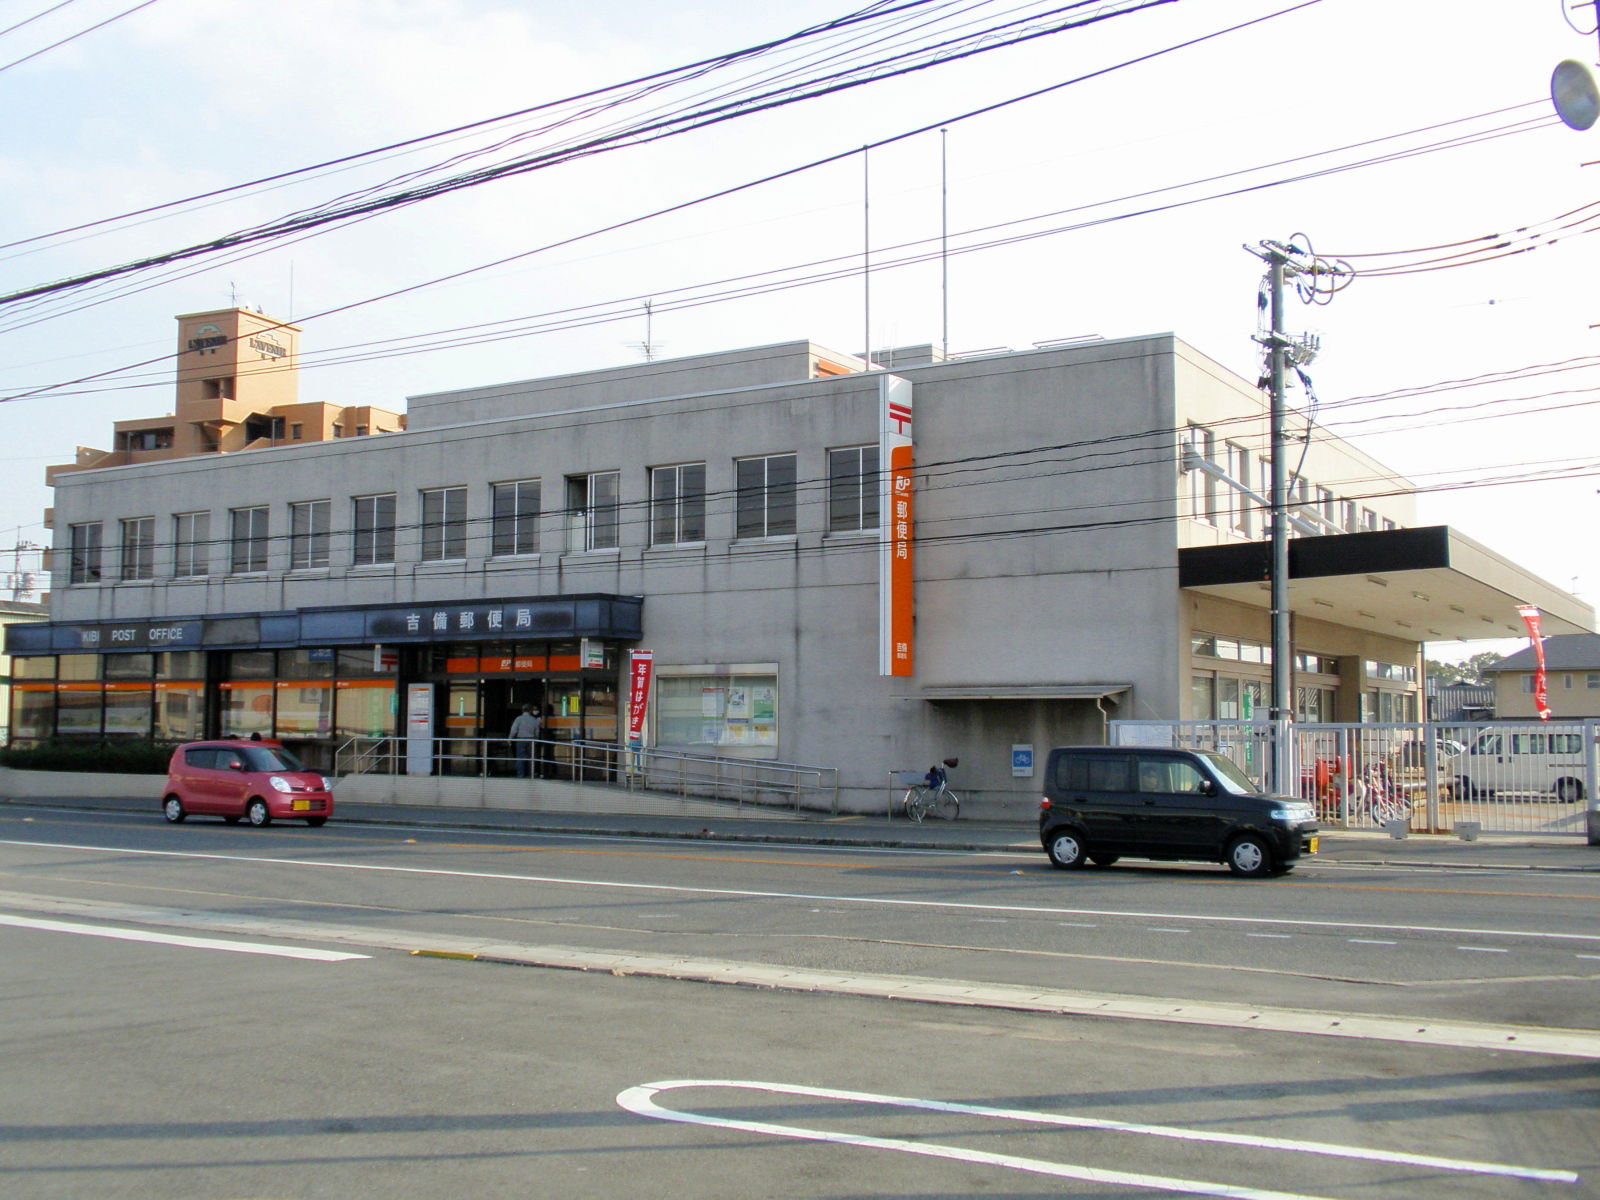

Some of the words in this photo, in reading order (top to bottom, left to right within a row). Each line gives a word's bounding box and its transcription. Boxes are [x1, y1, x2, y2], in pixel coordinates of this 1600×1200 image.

[897, 500, 908, 559] 郵便局
[82, 630, 100, 642] KIBI
[112, 629, 136, 641] POST
[149, 628, 183, 640] OFFICE
[406, 608, 532, 631] 吉備郵便局
[631, 663, 647, 728] 年賀はがき
